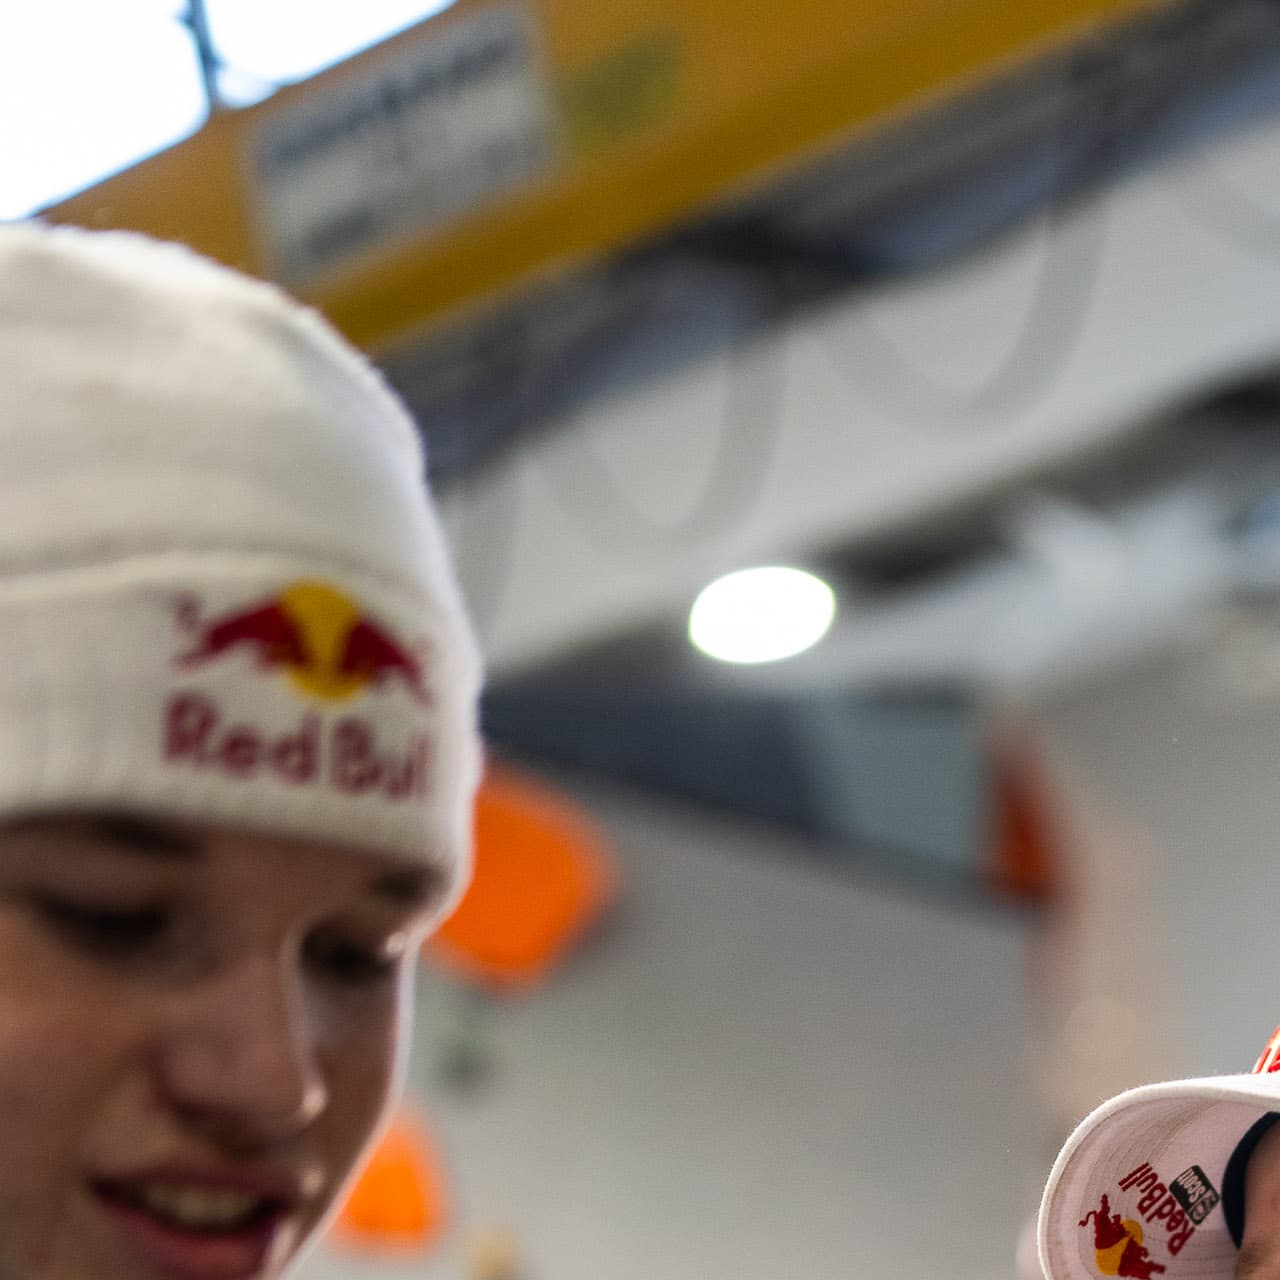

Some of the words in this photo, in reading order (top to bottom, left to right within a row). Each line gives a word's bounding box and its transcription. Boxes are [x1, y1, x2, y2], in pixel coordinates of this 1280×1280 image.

[165, 691, 321, 784] Red
[1118, 1162, 1168, 1217] Bull
[1145, 1194, 1196, 1256] Red
